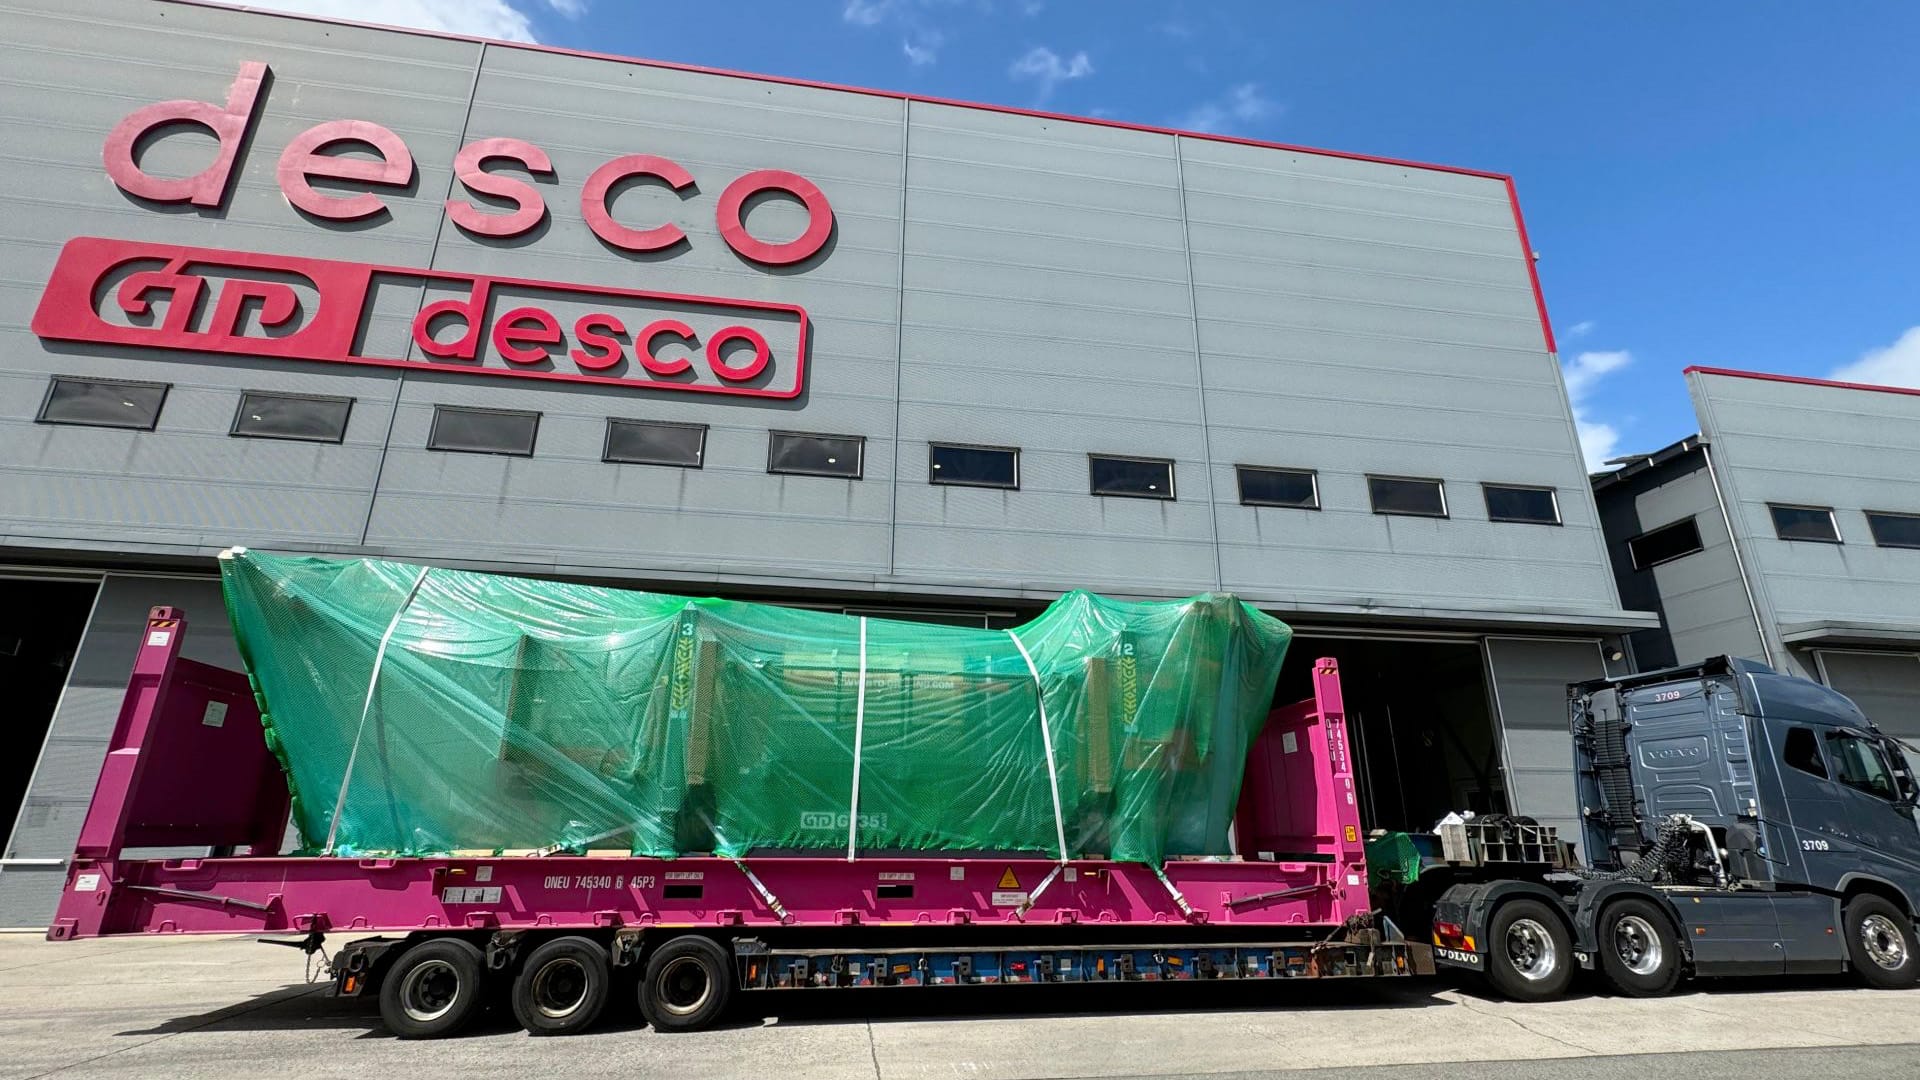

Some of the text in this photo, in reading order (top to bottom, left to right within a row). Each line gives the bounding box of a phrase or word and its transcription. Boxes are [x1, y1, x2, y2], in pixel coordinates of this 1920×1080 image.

[103, 60, 834, 266] desco
[412, 276, 770, 382] desco
[682, 623, 694, 636] 3
[1124, 643, 1134, 656] 2
[1655, 690, 1680, 702] 3709
[1648, 747, 1699, 760] VOLVO
[837, 813, 880, 829] G35
[1801, 839, 1829, 851] 3709
[544, 875, 655, 889] ONEU 745340 6 45P3
[1437, 948, 1479, 964] VOLVO
